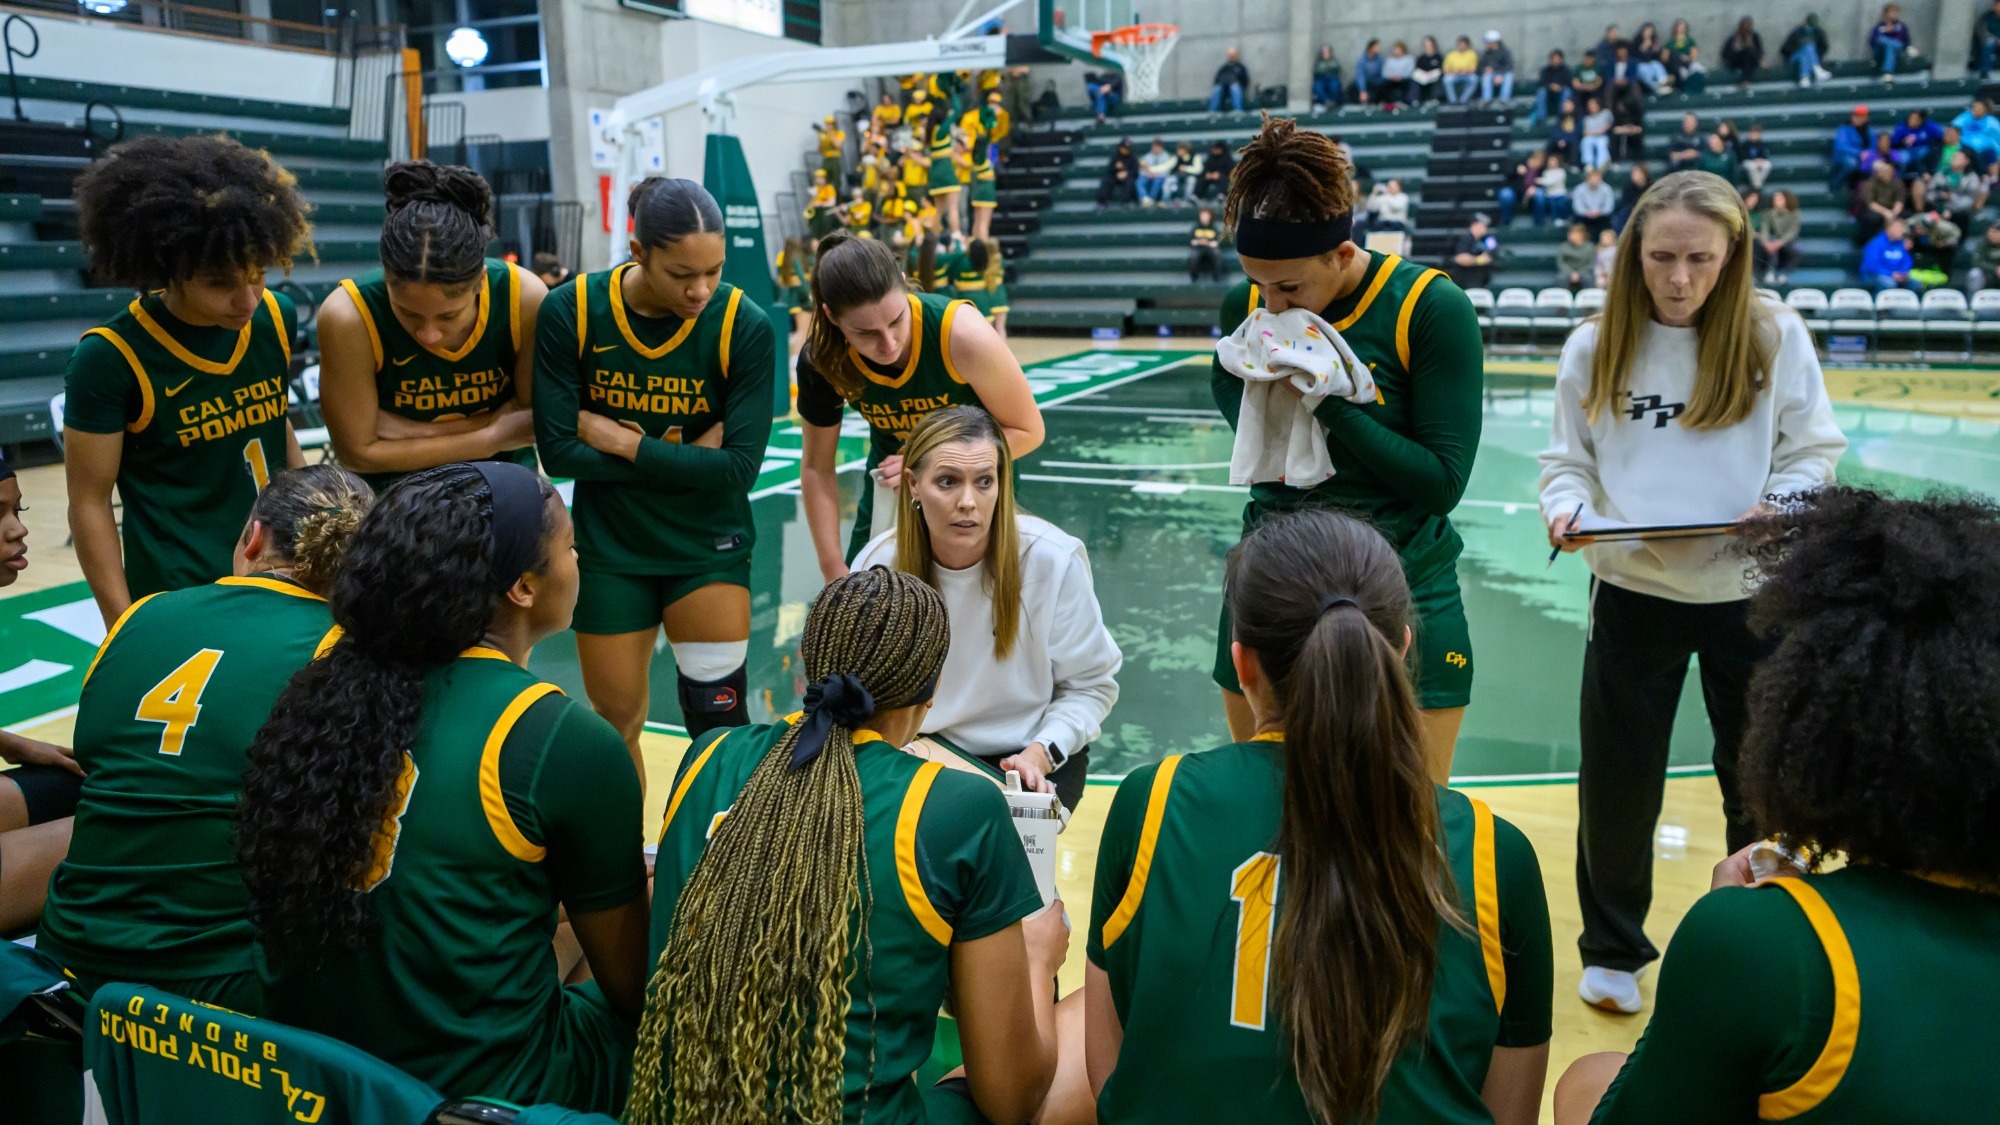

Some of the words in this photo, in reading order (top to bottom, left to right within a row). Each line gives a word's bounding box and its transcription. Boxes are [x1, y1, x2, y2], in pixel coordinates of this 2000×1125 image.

[179, 397, 232, 425] CAL
[232, 376, 282, 406] POLY
[400, 376, 449, 393] CAL
[453, 366, 505, 388] POL
[589, 384, 710, 415] POMONA
[595, 369, 641, 390] CAL
[647, 375, 705, 394] POLY
[860, 402, 898, 414] CAL
[900, 393, 949, 411] POLY
[176, 395, 288, 447] POMONA
[243, 438, 270, 497] 1
[1446, 652, 1467, 668] CPP
[135, 648, 225, 756] 4
[1230, 851, 1281, 1031] 1
[188, 1042, 262, 1089] POLY
[270, 1068, 326, 1124] CAL
